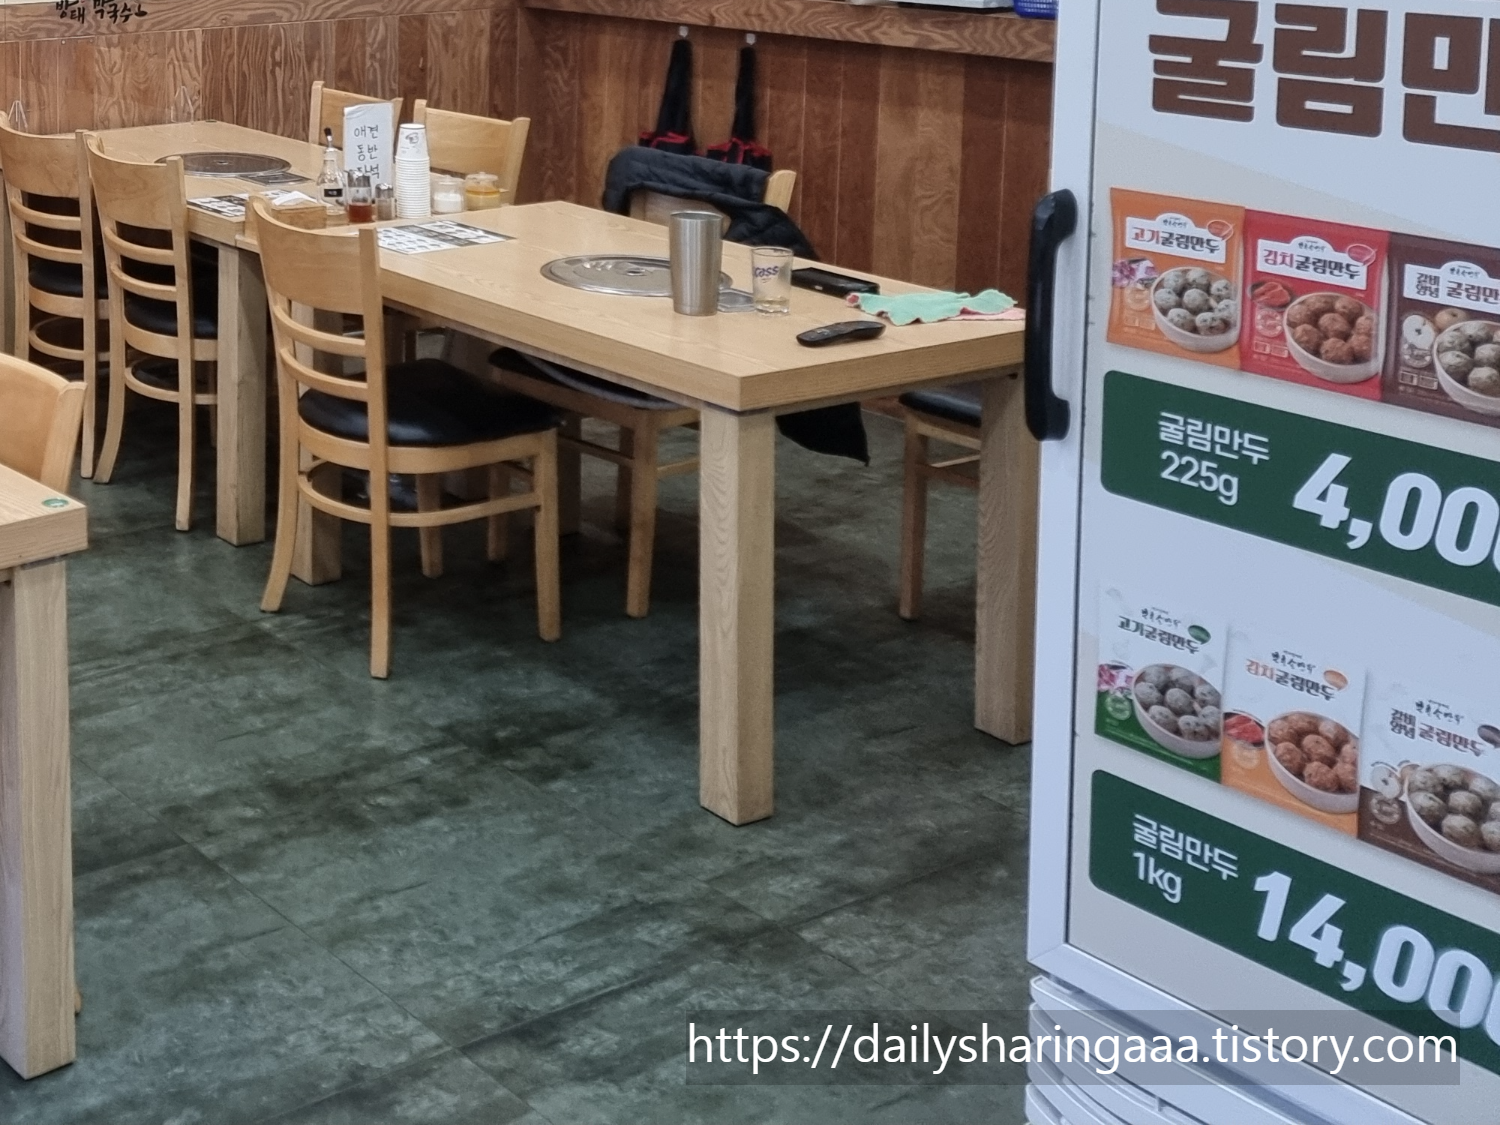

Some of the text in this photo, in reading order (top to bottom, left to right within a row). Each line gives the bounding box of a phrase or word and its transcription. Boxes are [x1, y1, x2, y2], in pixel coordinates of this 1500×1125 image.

[353, 124, 379, 139] 애견
[357, 144, 378, 161] 동반
[1131, 226, 1220, 254] 고기굴림만두
[1263, 248, 1361, 280] 김치굴림만두
[1157, 411, 1270, 466] 굴림만두
[1160, 450, 1239, 506] 225g
[1292, 452, 1500, 573] 4,00
[1117, 615, 1200, 654] 고기굴림만두
[1245, 658, 1335, 701] 김치굴림만두
[1418, 722, 1485, 757] 굴림만두
[1132, 813, 1239, 880] 굴림만두
[1132, 851, 1183, 904] 1kg
[1254, 870, 1500, 1048] 14,00
